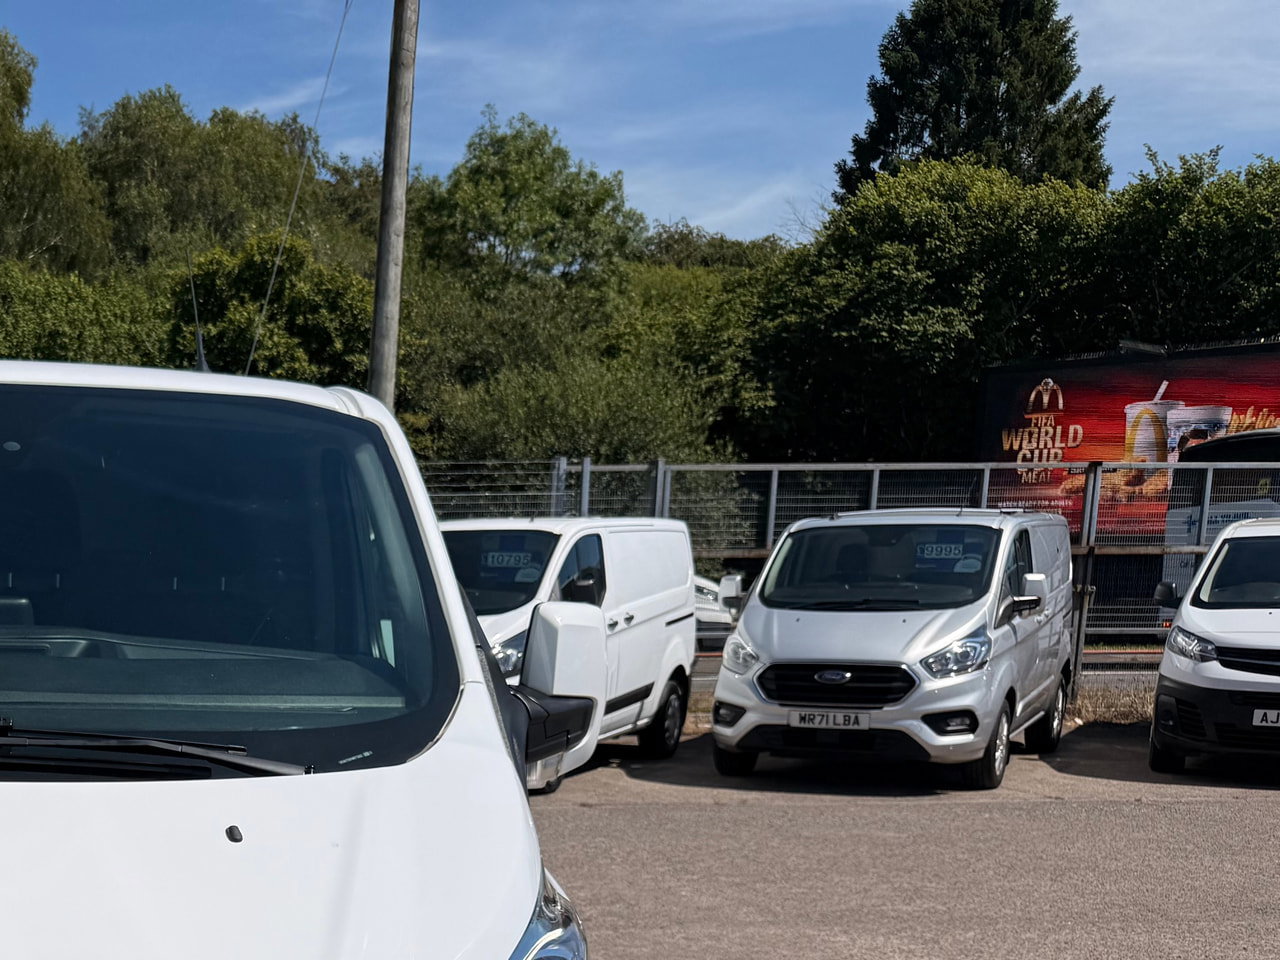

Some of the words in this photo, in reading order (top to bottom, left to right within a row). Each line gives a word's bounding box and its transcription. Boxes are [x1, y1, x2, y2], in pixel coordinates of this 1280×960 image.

[1031, 414, 1055, 427] FIFA
[1002, 424, 1084, 451] WORLD
[1016, 448, 1063, 475] CUP
[799, 713, 829, 726] WR71
[833, 714, 860, 726] LBA
